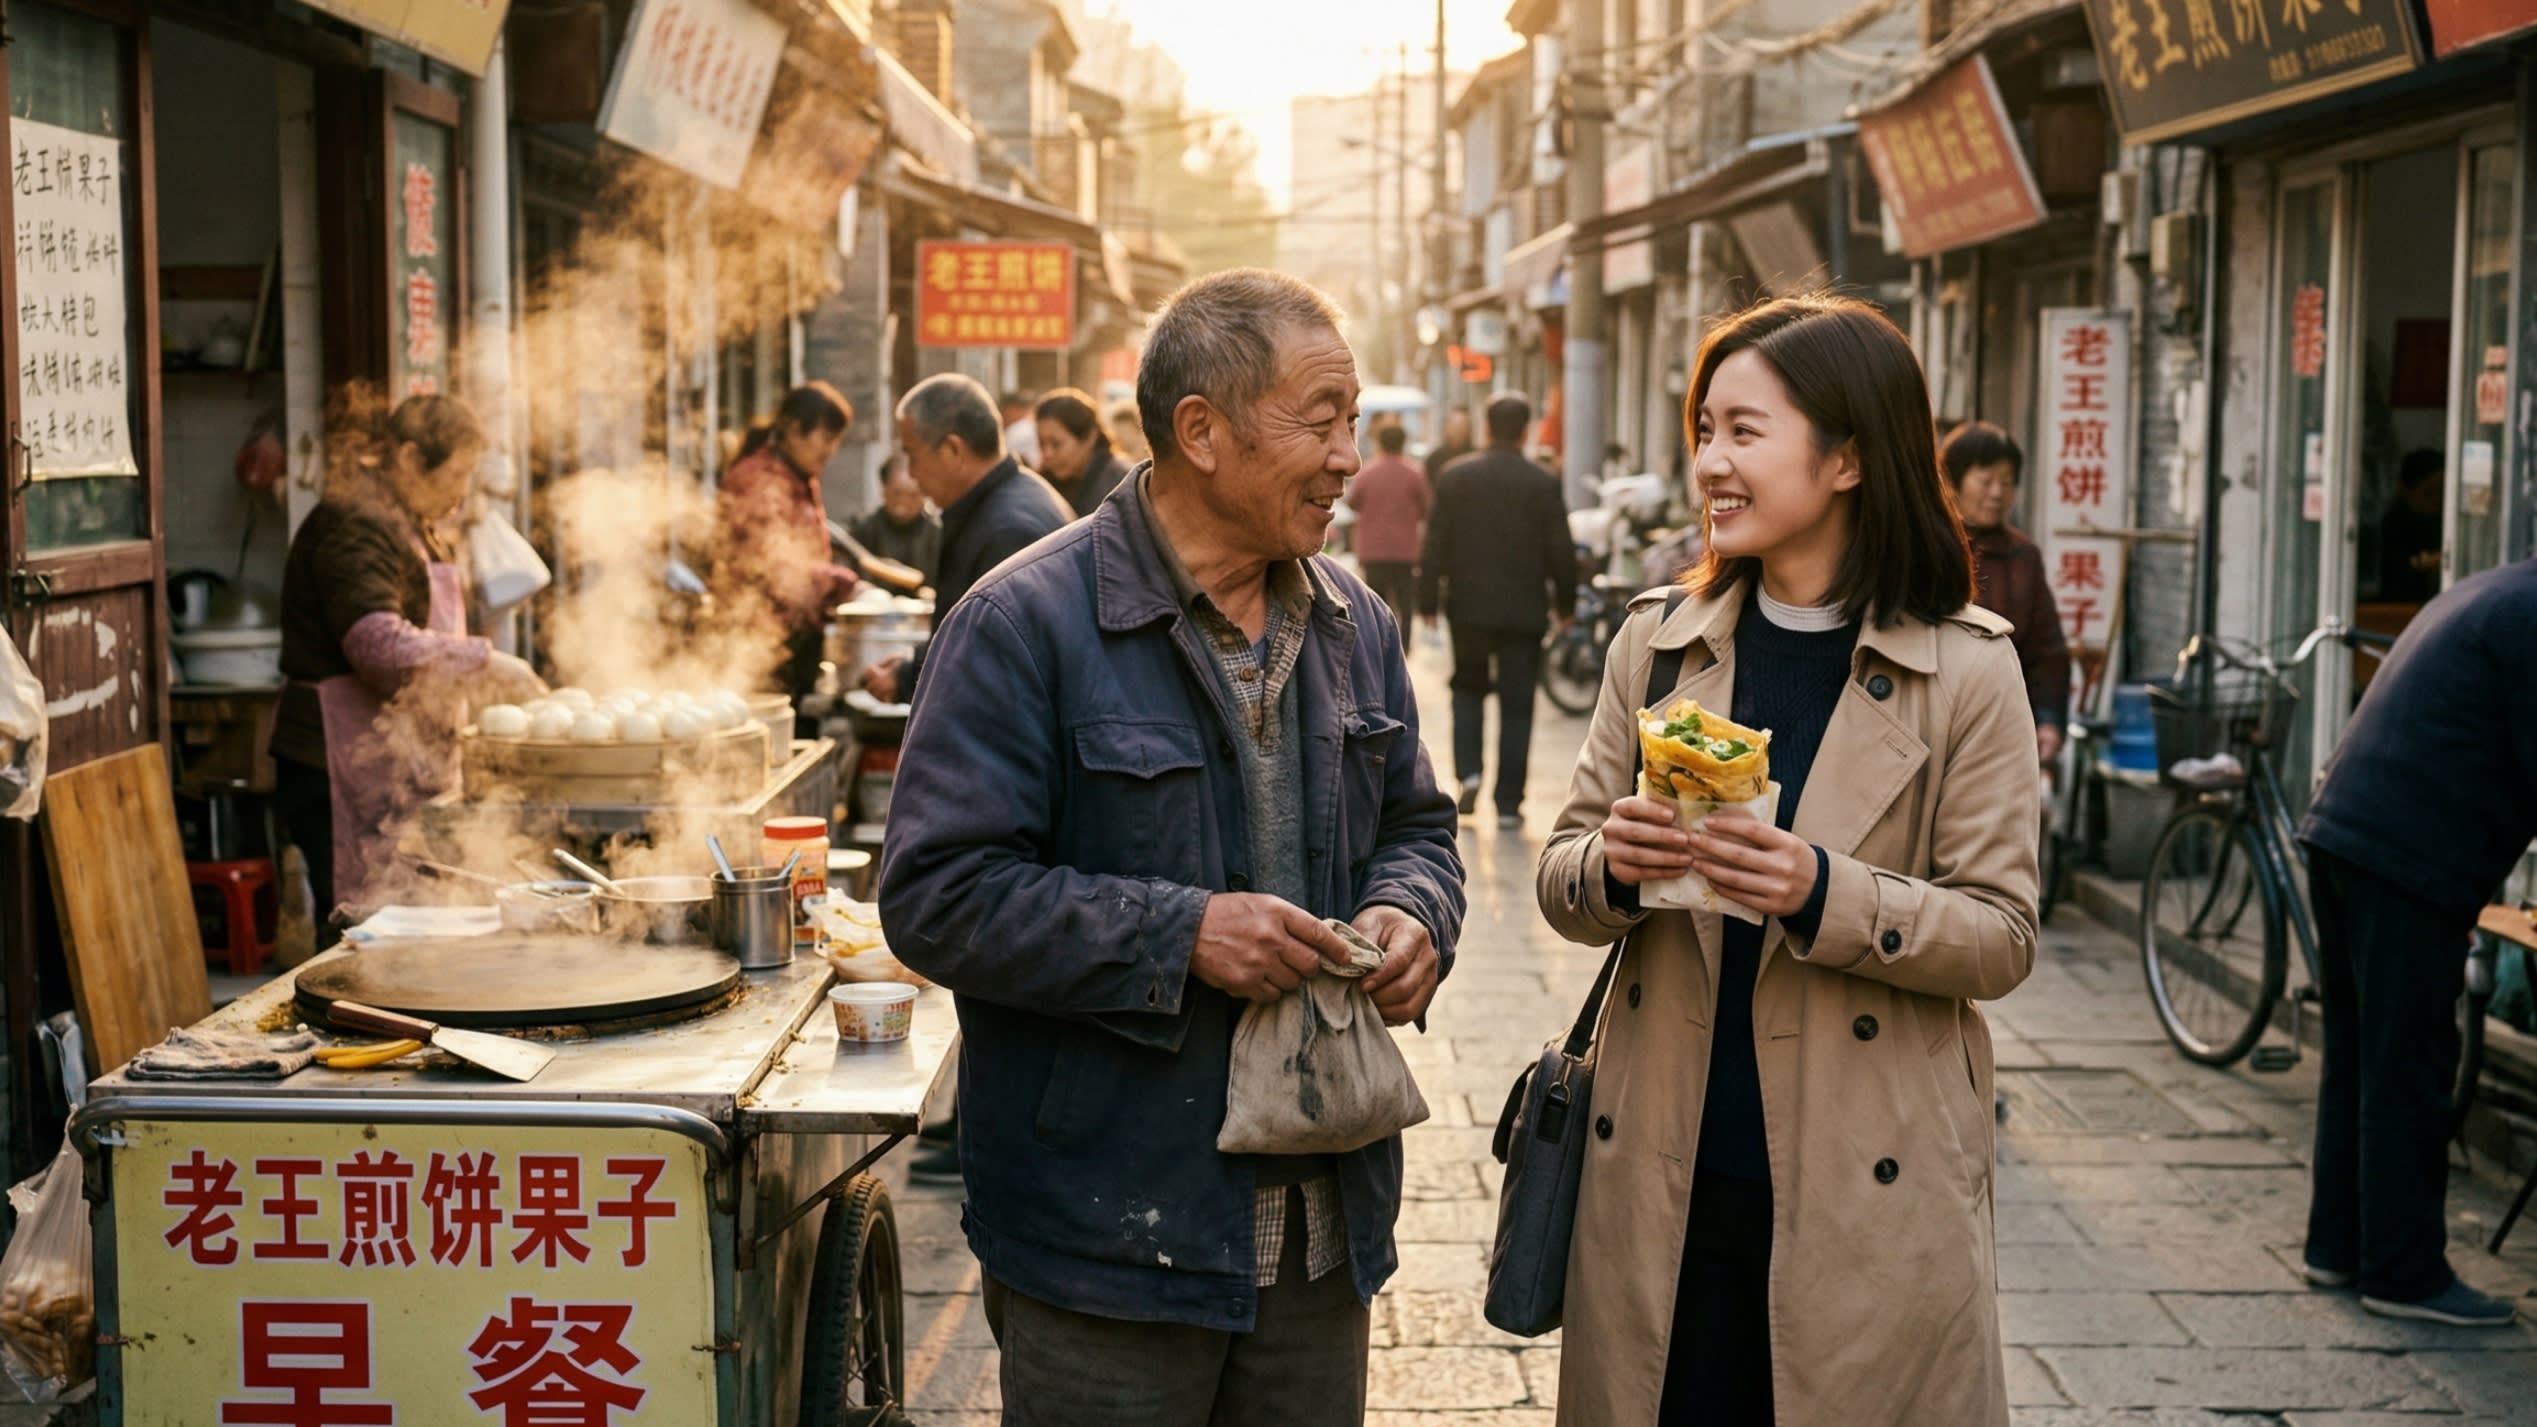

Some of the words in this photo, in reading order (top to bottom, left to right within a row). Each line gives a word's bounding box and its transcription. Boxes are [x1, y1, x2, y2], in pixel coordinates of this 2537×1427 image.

[2057, 325, 2111, 637] 老王煎饼果子
[163, 1149, 678, 1269] 老王煎饼果子
[221, 1297, 647, 1427] 早餐
